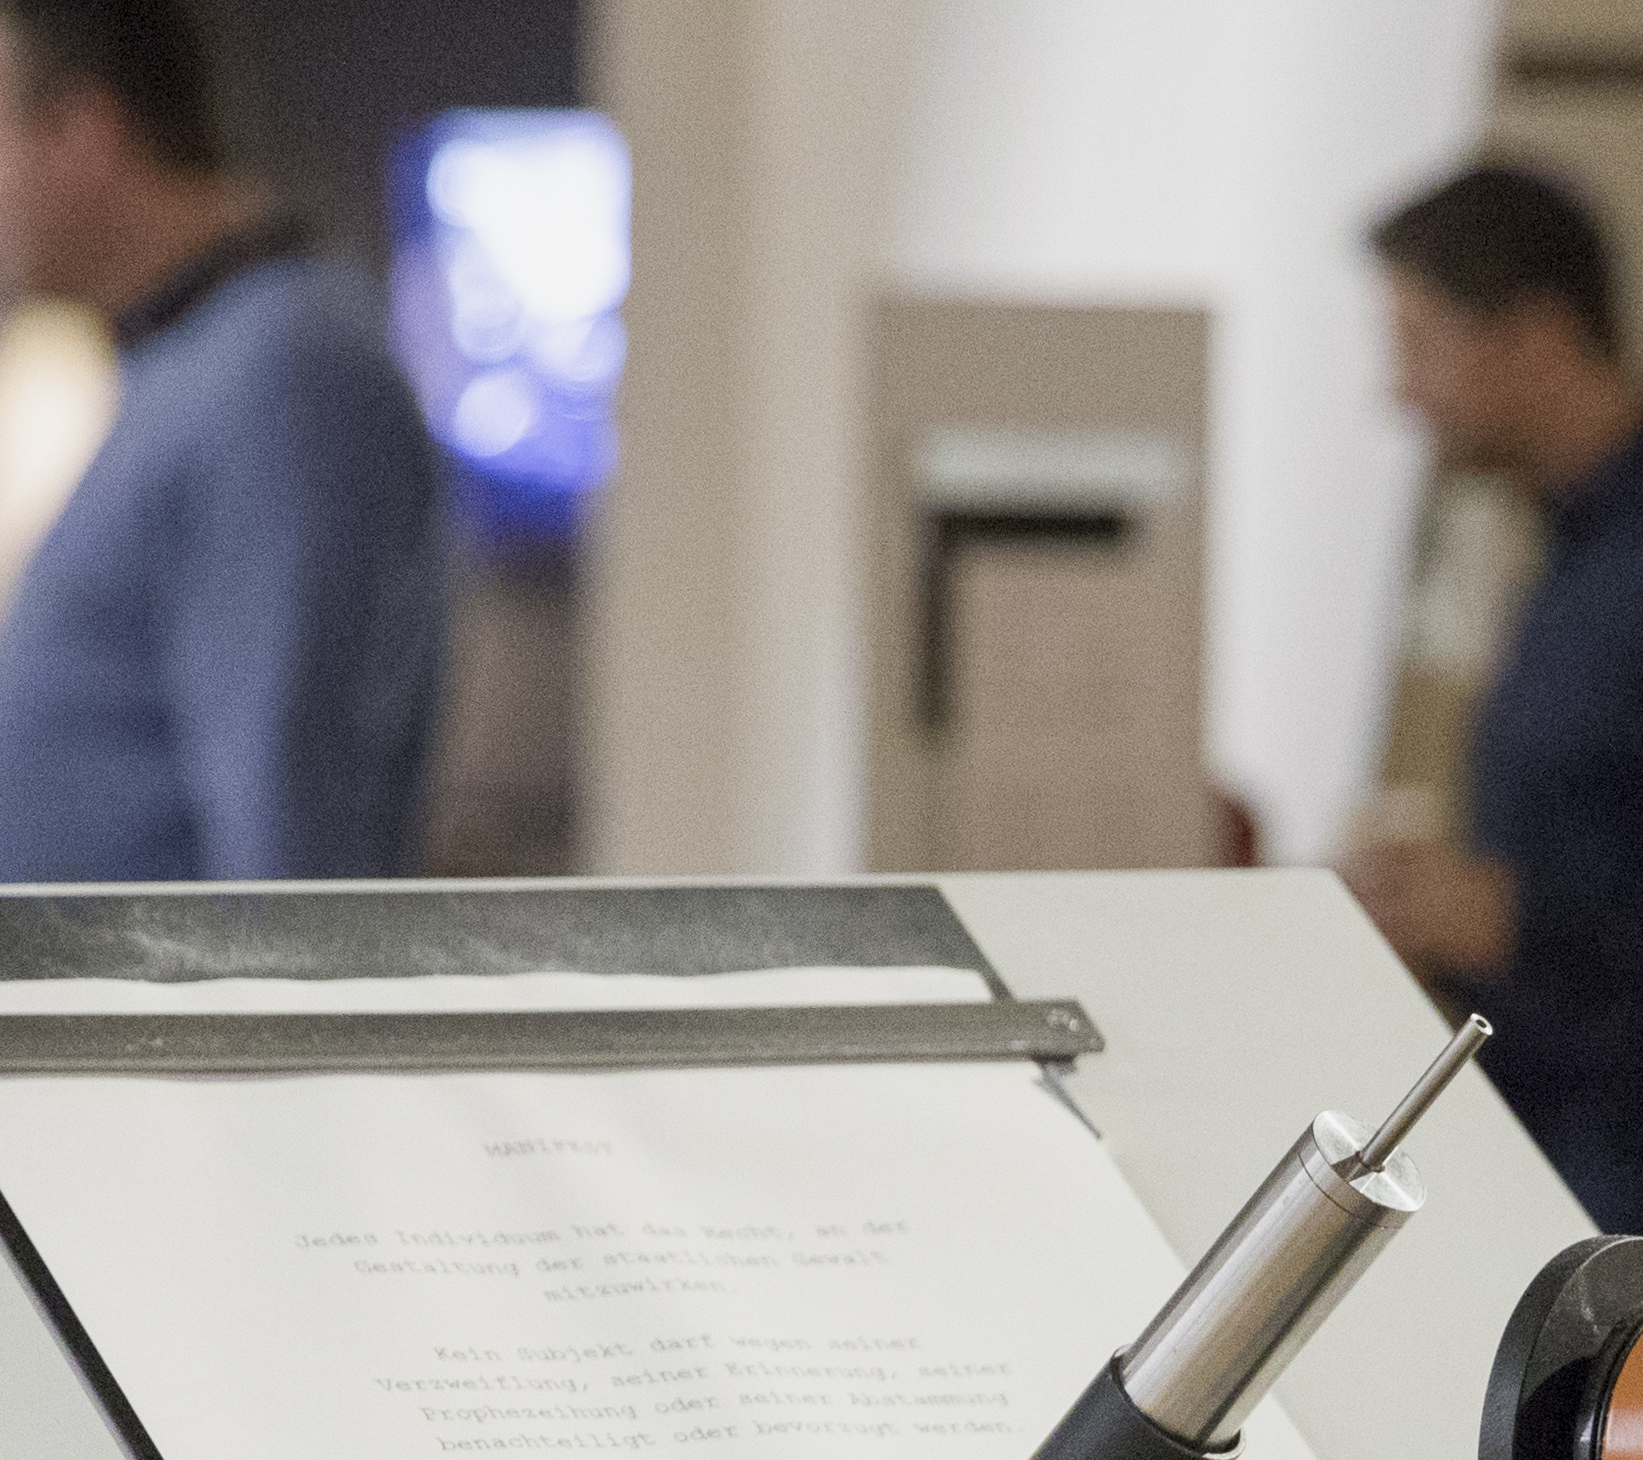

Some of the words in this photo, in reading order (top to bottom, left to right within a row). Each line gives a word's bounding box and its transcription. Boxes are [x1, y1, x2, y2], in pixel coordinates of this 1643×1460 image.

[569, 1223, 623, 1239] hat
[432, 1346, 502, 1362] Kein
[649, 1333, 712, 1353] darf
[654, 1396, 719, 1415] oder
[673, 1424, 739, 1444] oder
